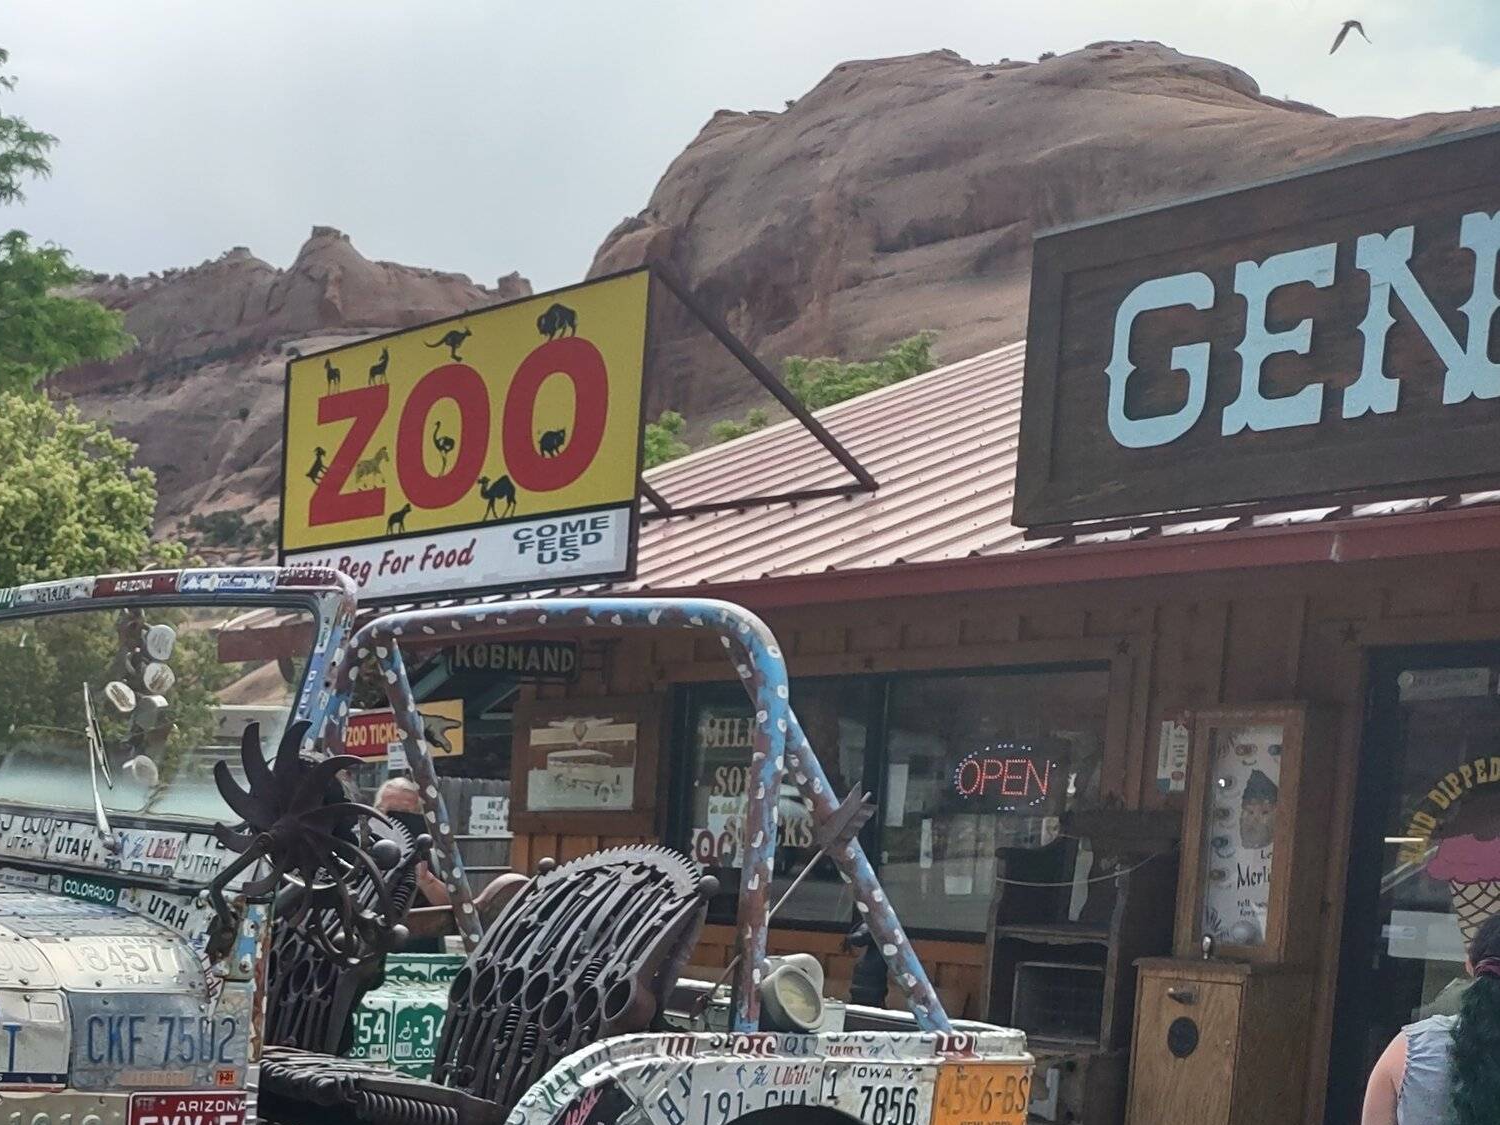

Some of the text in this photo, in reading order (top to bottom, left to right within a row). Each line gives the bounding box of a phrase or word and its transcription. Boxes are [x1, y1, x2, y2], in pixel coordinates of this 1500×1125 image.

[308, 337, 610, 527] ZOO
[513, 515, 610, 543] COME
[517, 530, 603, 556] FEED
[537, 546, 581, 565] US
[338, 555, 369, 587] Beg
[378, 549, 411, 577] For
[420, 539, 474, 571] Food
[114, 578, 154, 592] ARIZONA
[345, 725, 368, 748] ZOO
[958, 759, 1051, 797] OPEN
[1428, 755, 1500, 810] DIPPED
[55, 836, 93, 857] UTAH
[63, 878, 115, 902] COLORADO
[147, 894, 191, 931] UTAH
[86, 1015, 146, 1065] CKF
[851, 1065, 892, 1079] IOWA
[176, 1099, 247, 1113] ARIZONA
